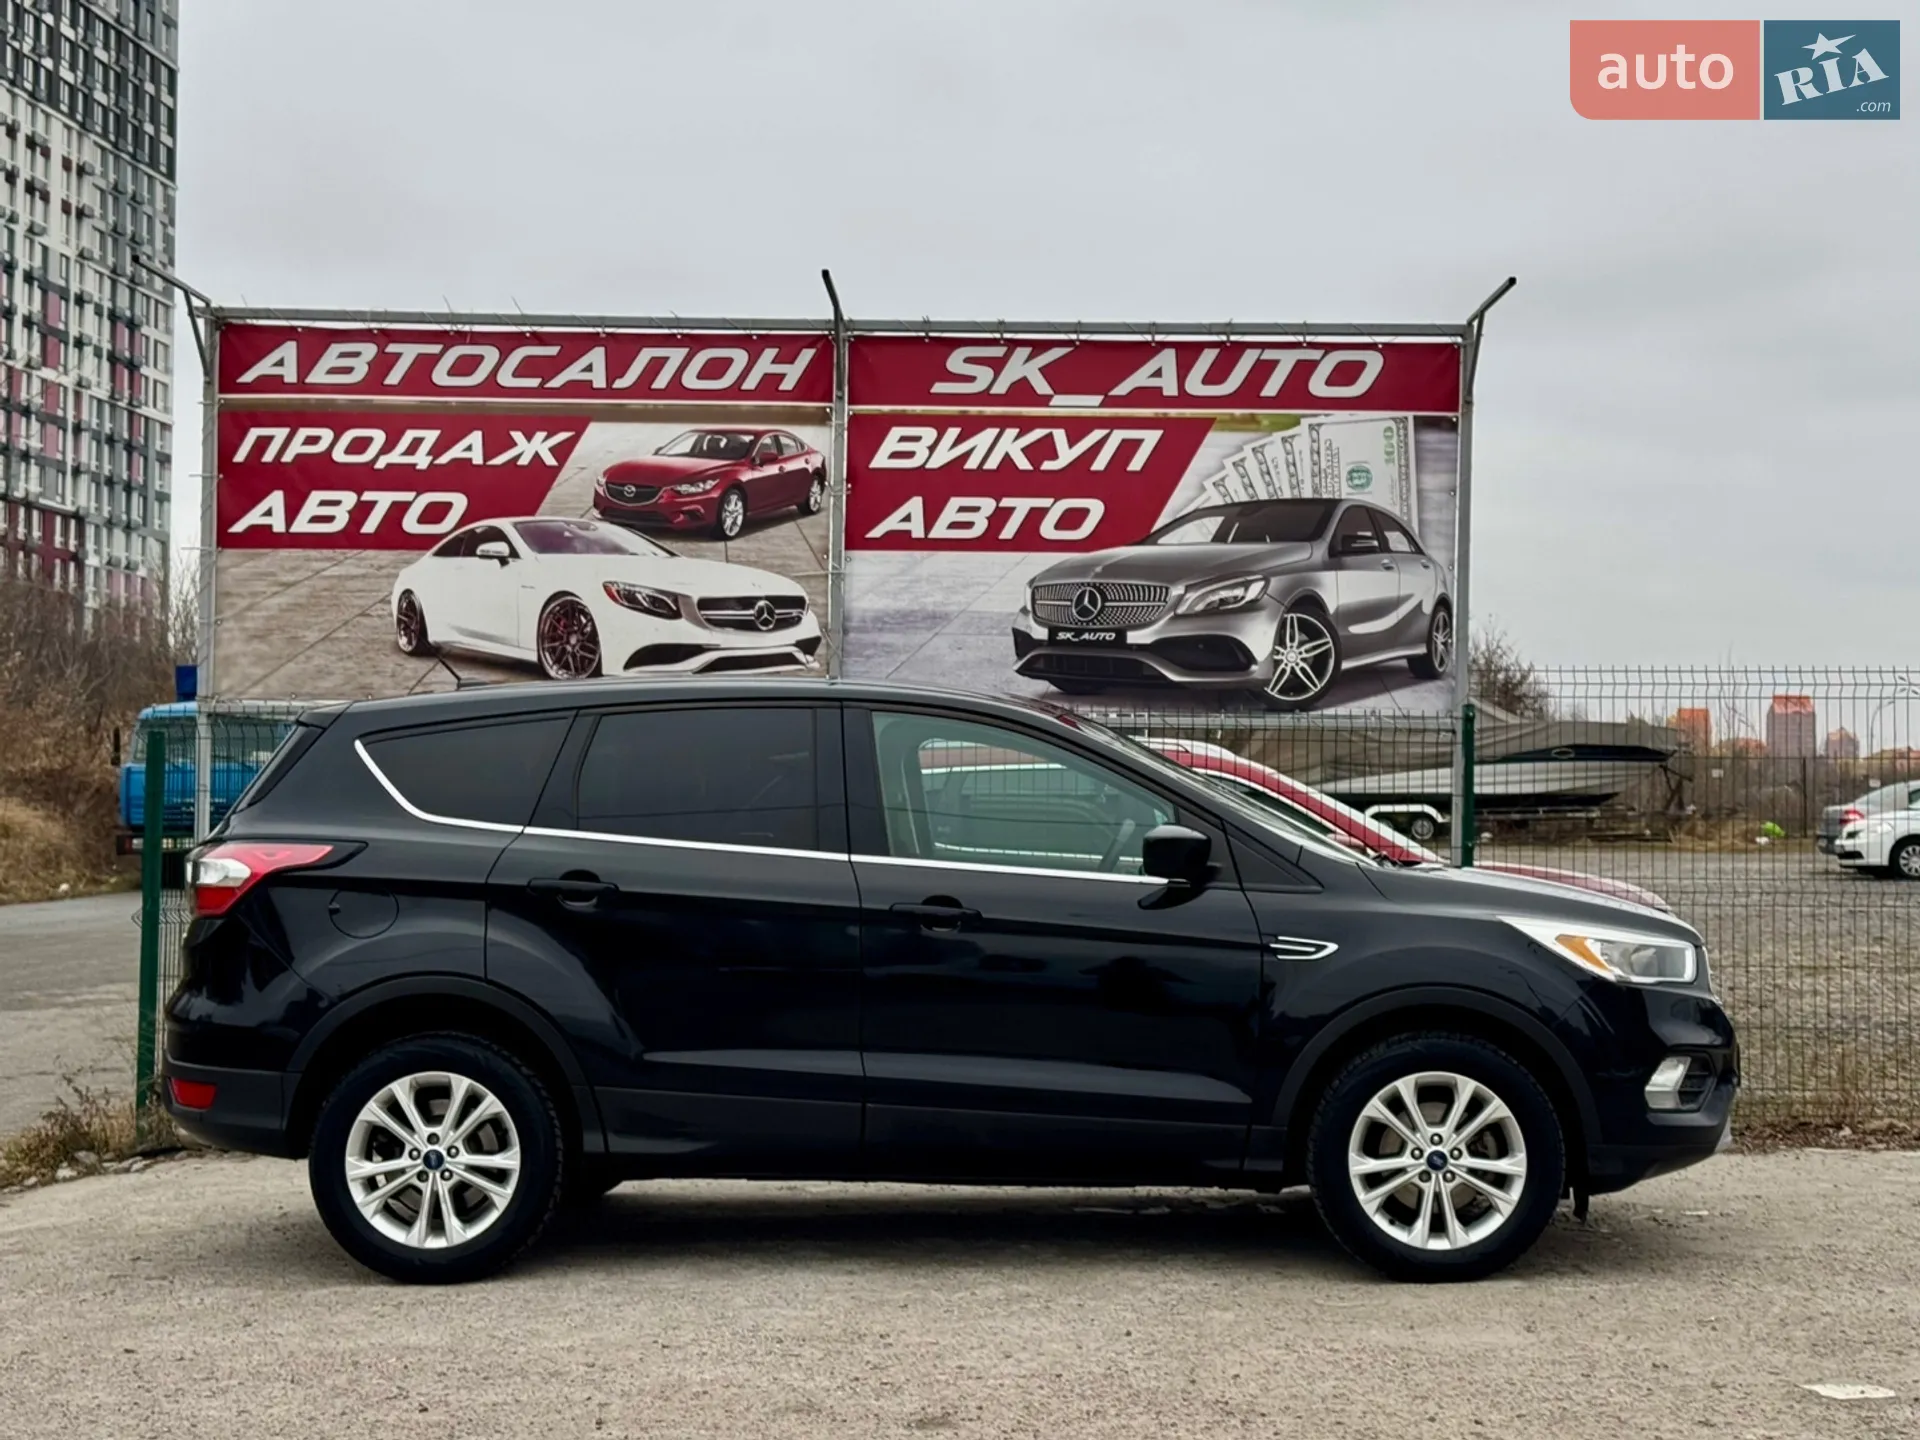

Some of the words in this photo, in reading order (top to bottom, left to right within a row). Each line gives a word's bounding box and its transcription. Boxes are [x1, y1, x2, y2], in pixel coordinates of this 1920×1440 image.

[236, 340, 818, 391] АВТОСАЛОН
[929, 346, 1384, 407] SK_AUTO
[232, 427, 576, 471] ПРОДАЖ
[868, 426, 1164, 472] ВИКУП
[227, 489, 468, 535] АВТО
[865, 495, 1105, 540] АВТО
[1056, 631, 1116, 642] SK_AUTO
